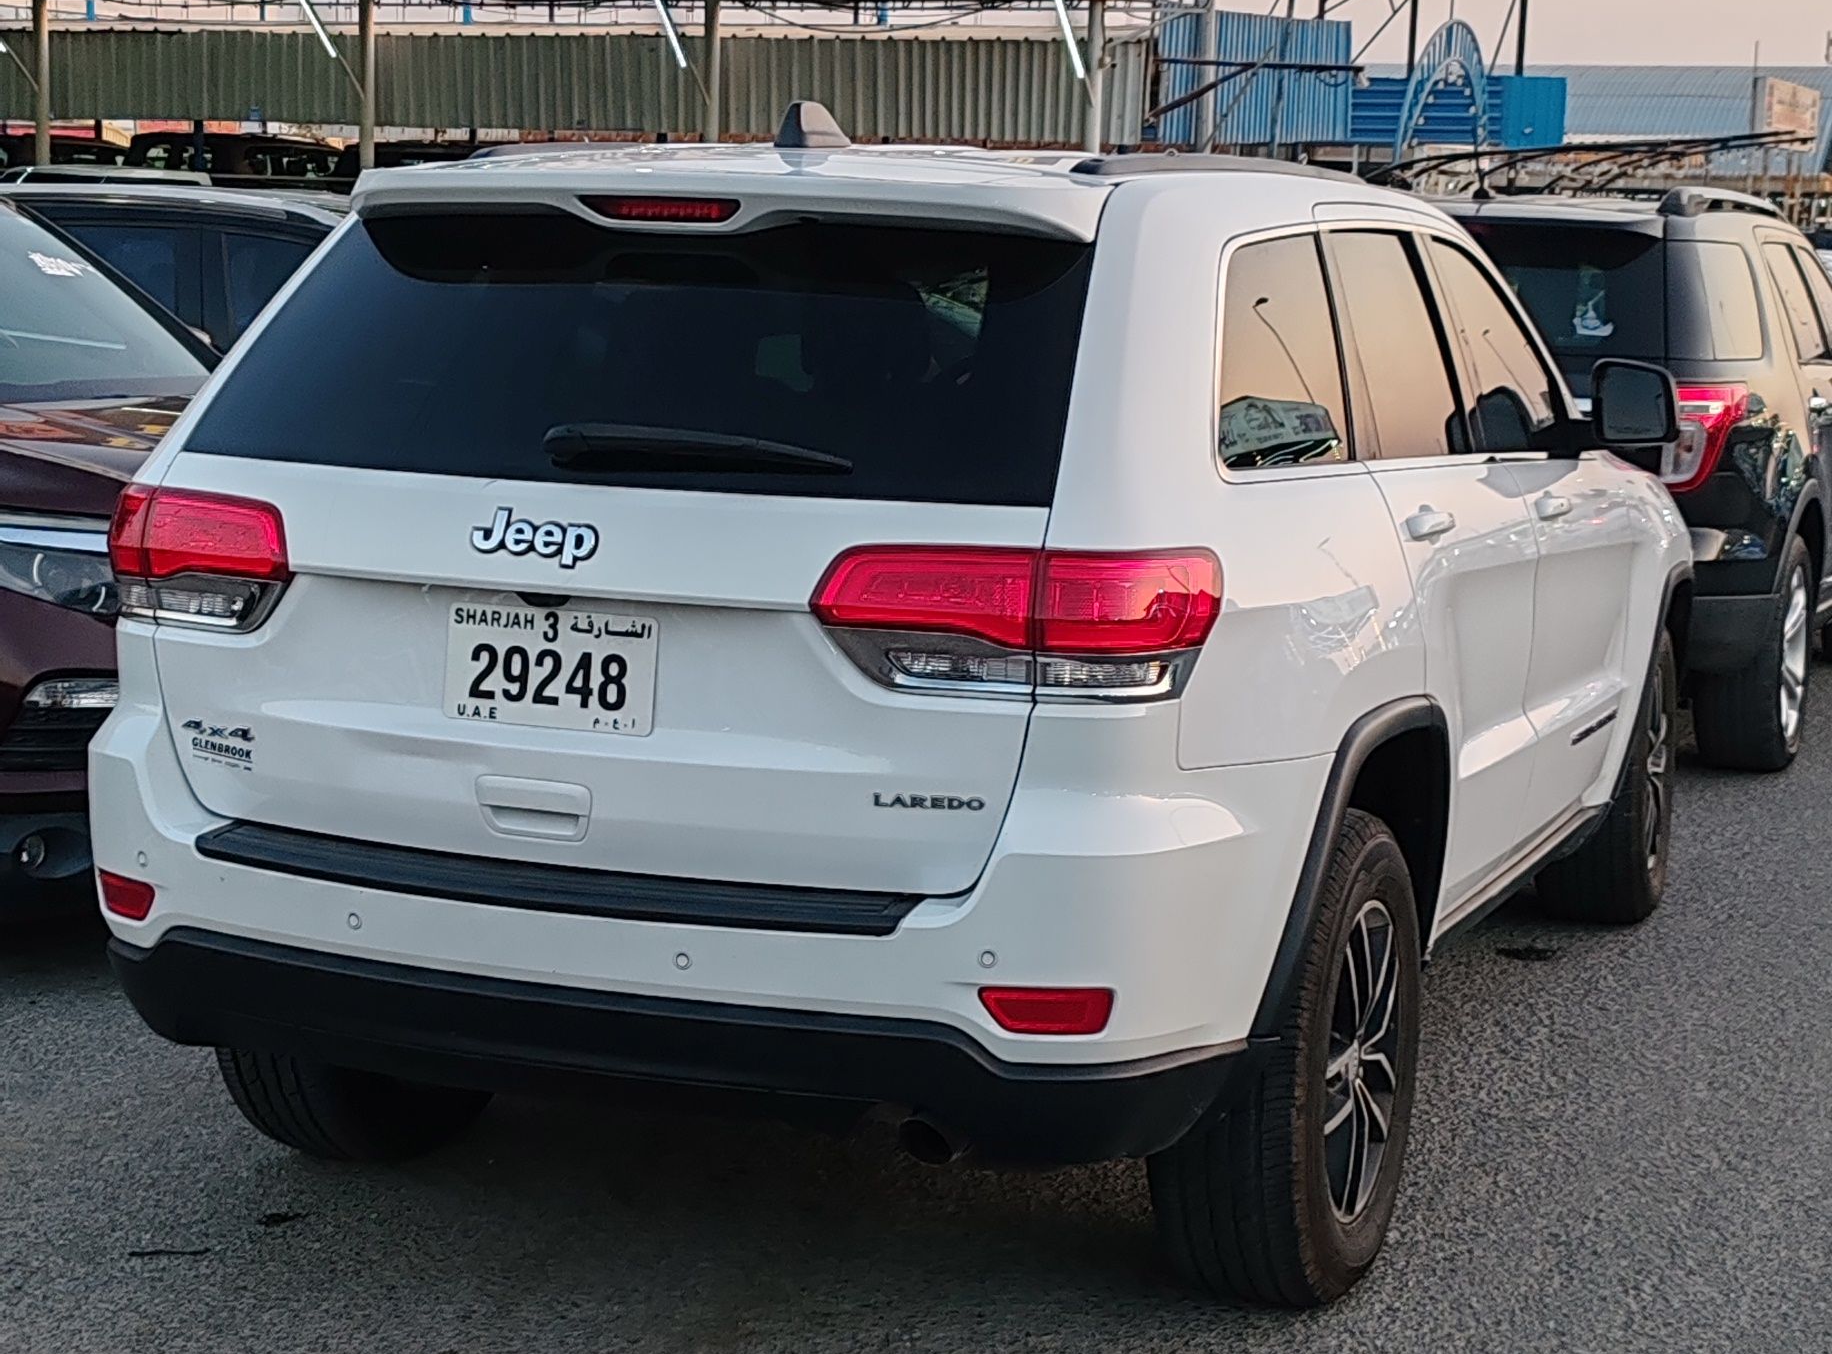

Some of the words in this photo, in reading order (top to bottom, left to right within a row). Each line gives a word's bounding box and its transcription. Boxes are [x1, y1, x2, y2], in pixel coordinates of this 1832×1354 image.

[470, 506, 599, 568] Jeep
[453, 607, 535, 630] SHARJAH
[543, 611, 560, 643] 3
[569, 615, 652, 639] الشارقة
[468, 643, 628, 711] 29248
[191, 736, 253, 760] GLENBROOK
[873, 792, 985, 811] LAREDO
